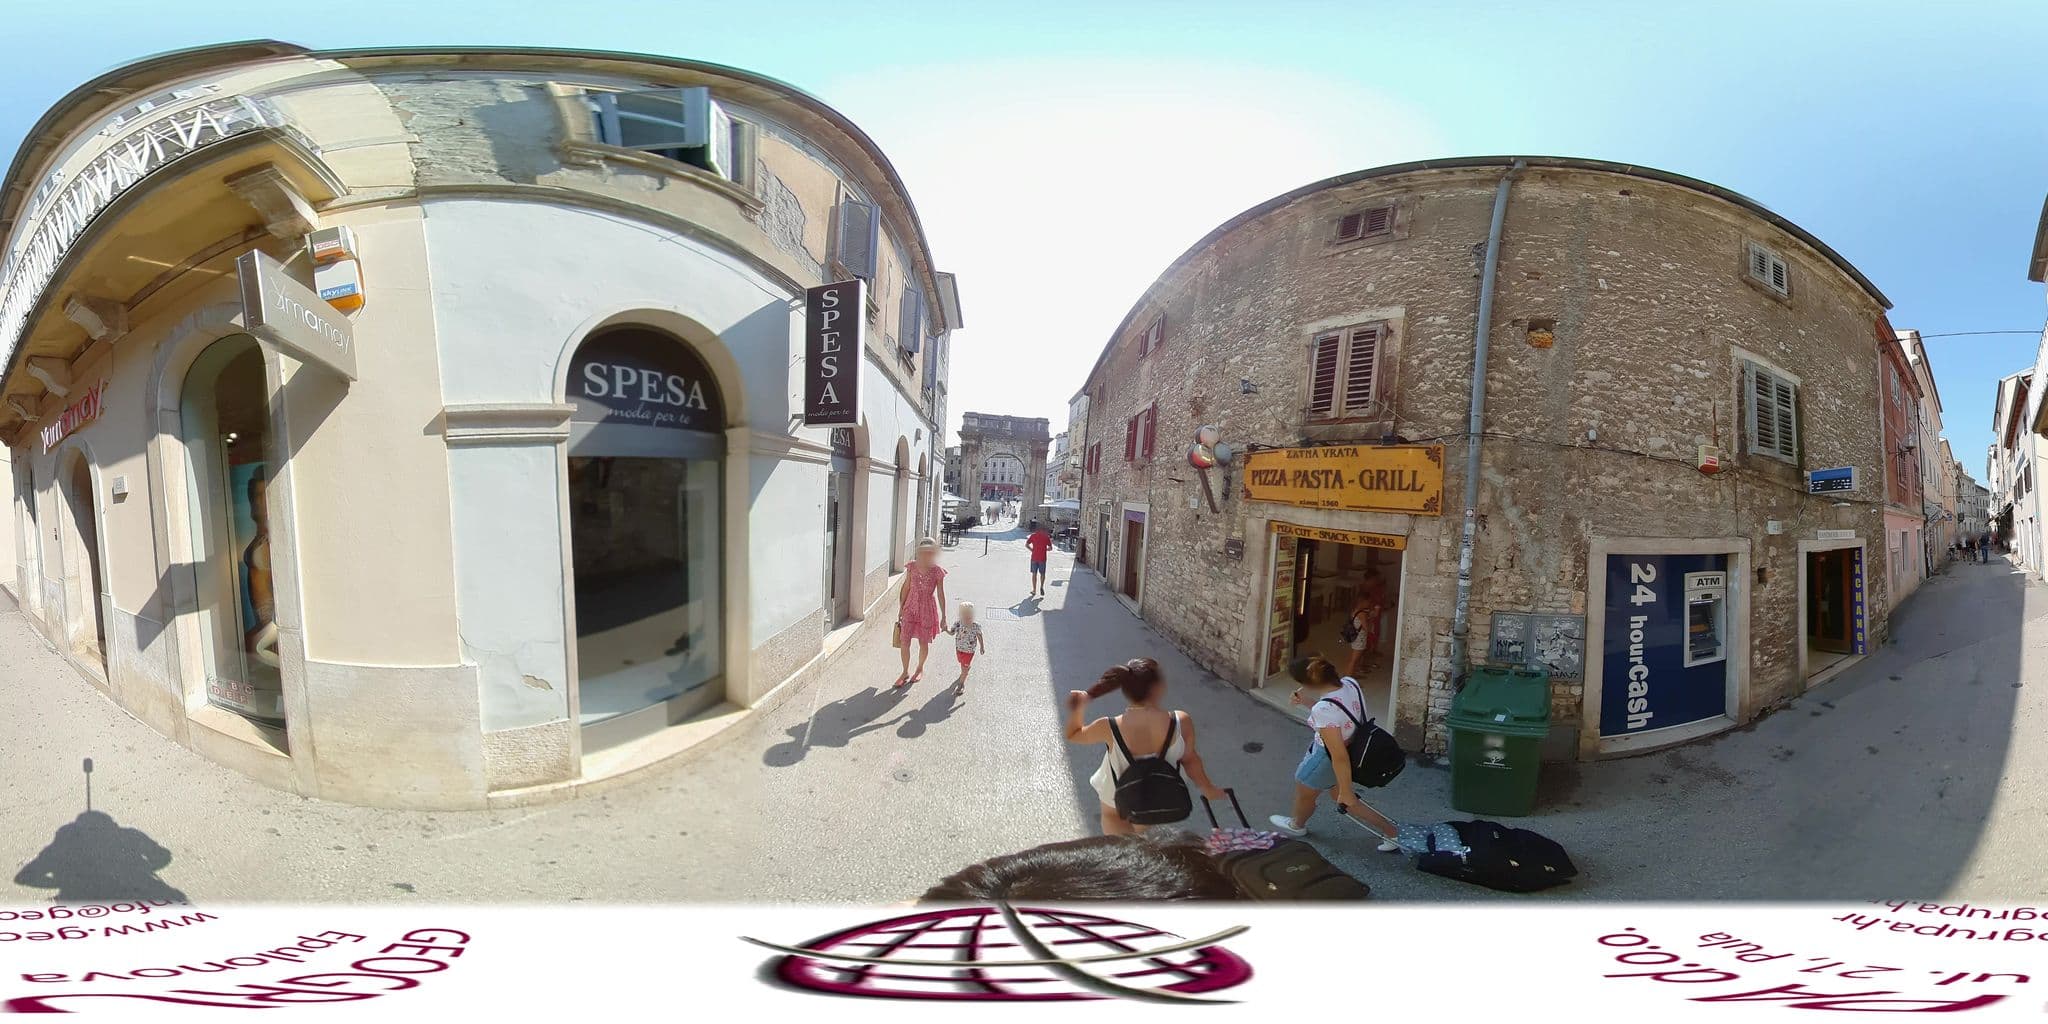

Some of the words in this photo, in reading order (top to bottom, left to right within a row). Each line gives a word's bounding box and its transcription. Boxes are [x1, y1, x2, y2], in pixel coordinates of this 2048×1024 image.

[818, 289, 841, 405] SPESA
[583, 362, 708, 410] SPESA
[607, 401, 650, 419] moda
[652, 412, 674, 428] per
[1322, 447, 1359, 458] VRATA
[1251, 469, 1288, 487] PIZZA
[1293, 469, 1345, 490] PASTA
[1358, 468, 1426, 493] GRILL
[1319, 530, 1350, 542] SNACK
[1359, 535, 1396, 548] KEBAB
[1630, 563, 1656, 607] 24
[1696, 577, 1720, 587] ATM
